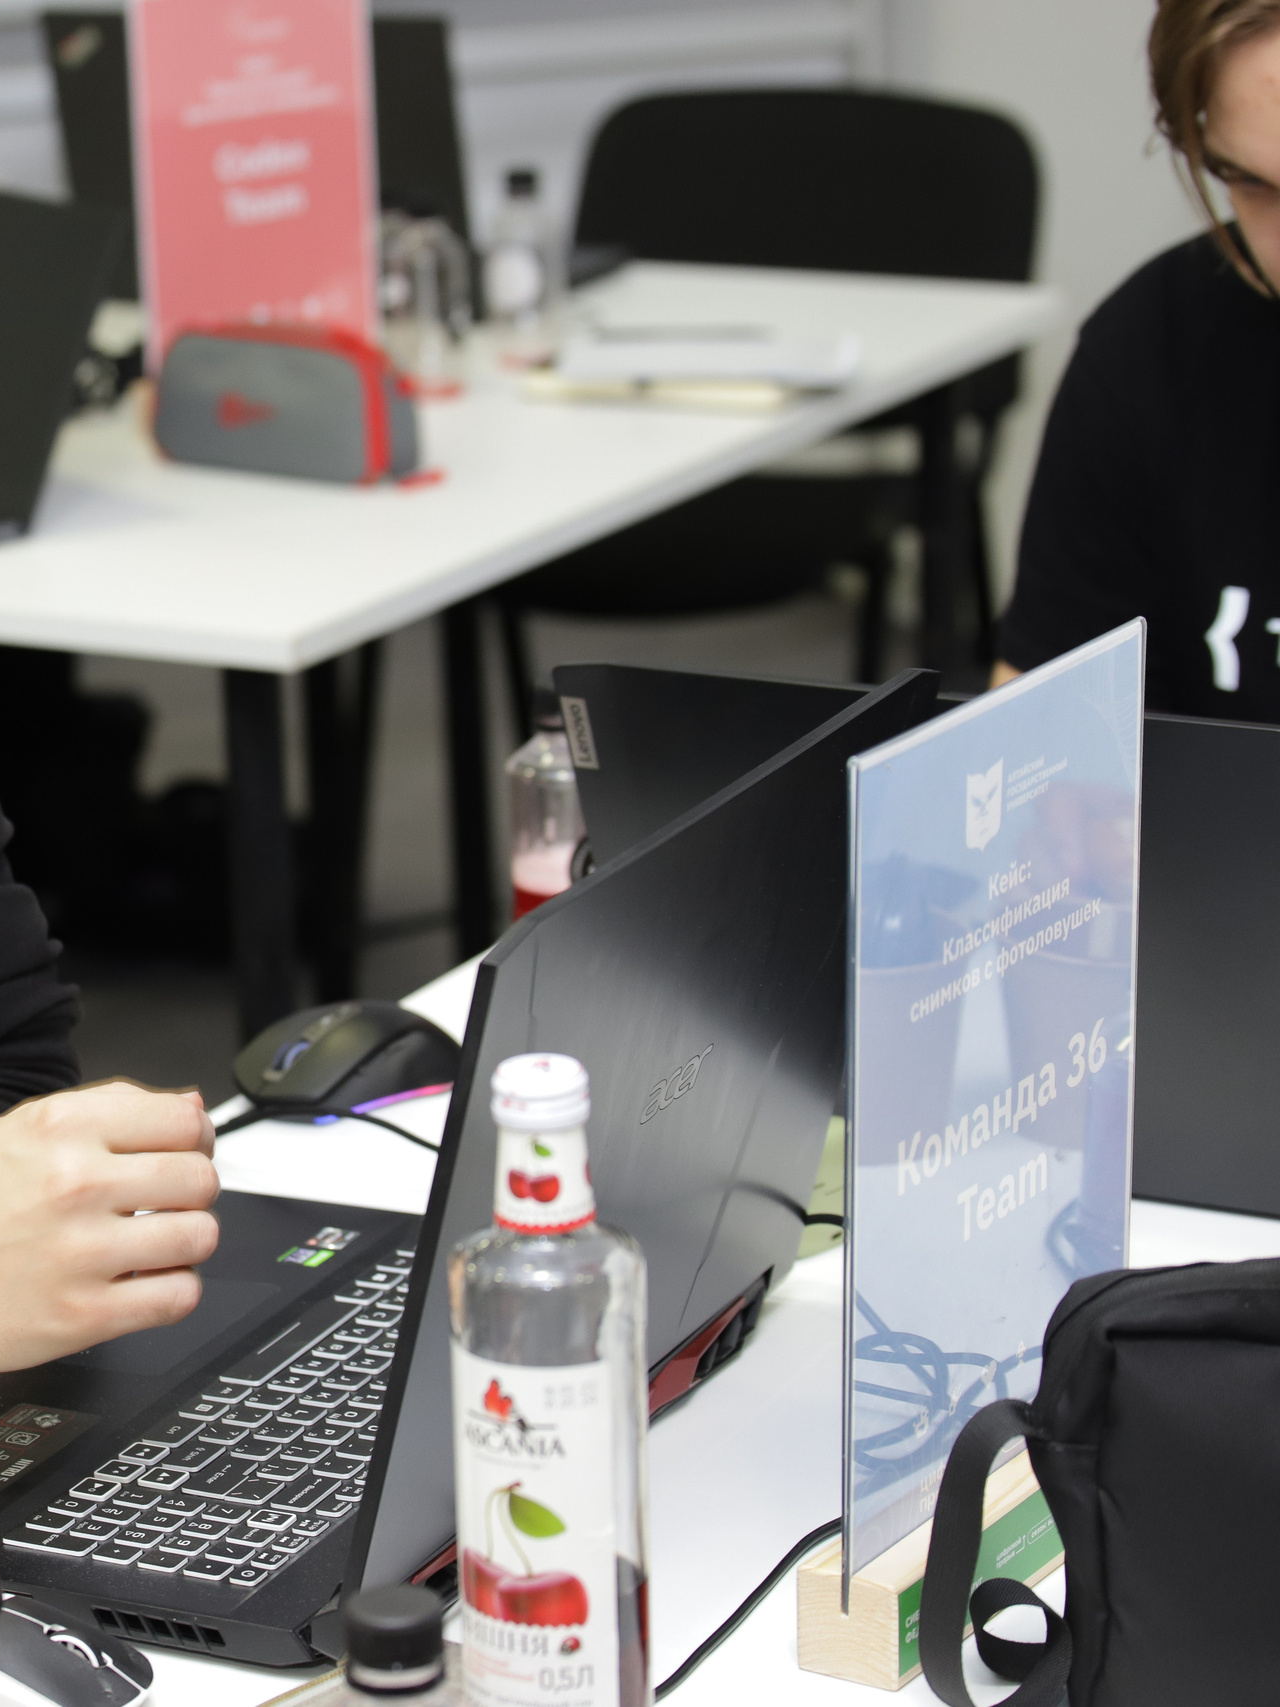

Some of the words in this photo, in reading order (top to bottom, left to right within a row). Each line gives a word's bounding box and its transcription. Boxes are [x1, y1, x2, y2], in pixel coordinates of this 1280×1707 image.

[571, 703, 593, 763] Lenovo
[943, 877, 1070, 966] Классификация
[988, 860, 1032, 901] Кейс:
[910, 967, 981, 1023] снимков
[984, 959, 993, 981] с
[996, 897, 1102, 978] фотоловушек
[639, 1042, 715, 1126] acer
[897, 1062, 1057, 1197] Команда
[1066, 1016, 1108, 1089] 36
[956, 1151, 1049, 1242] Team
[0, 1458, 34, 1477] NITRO
